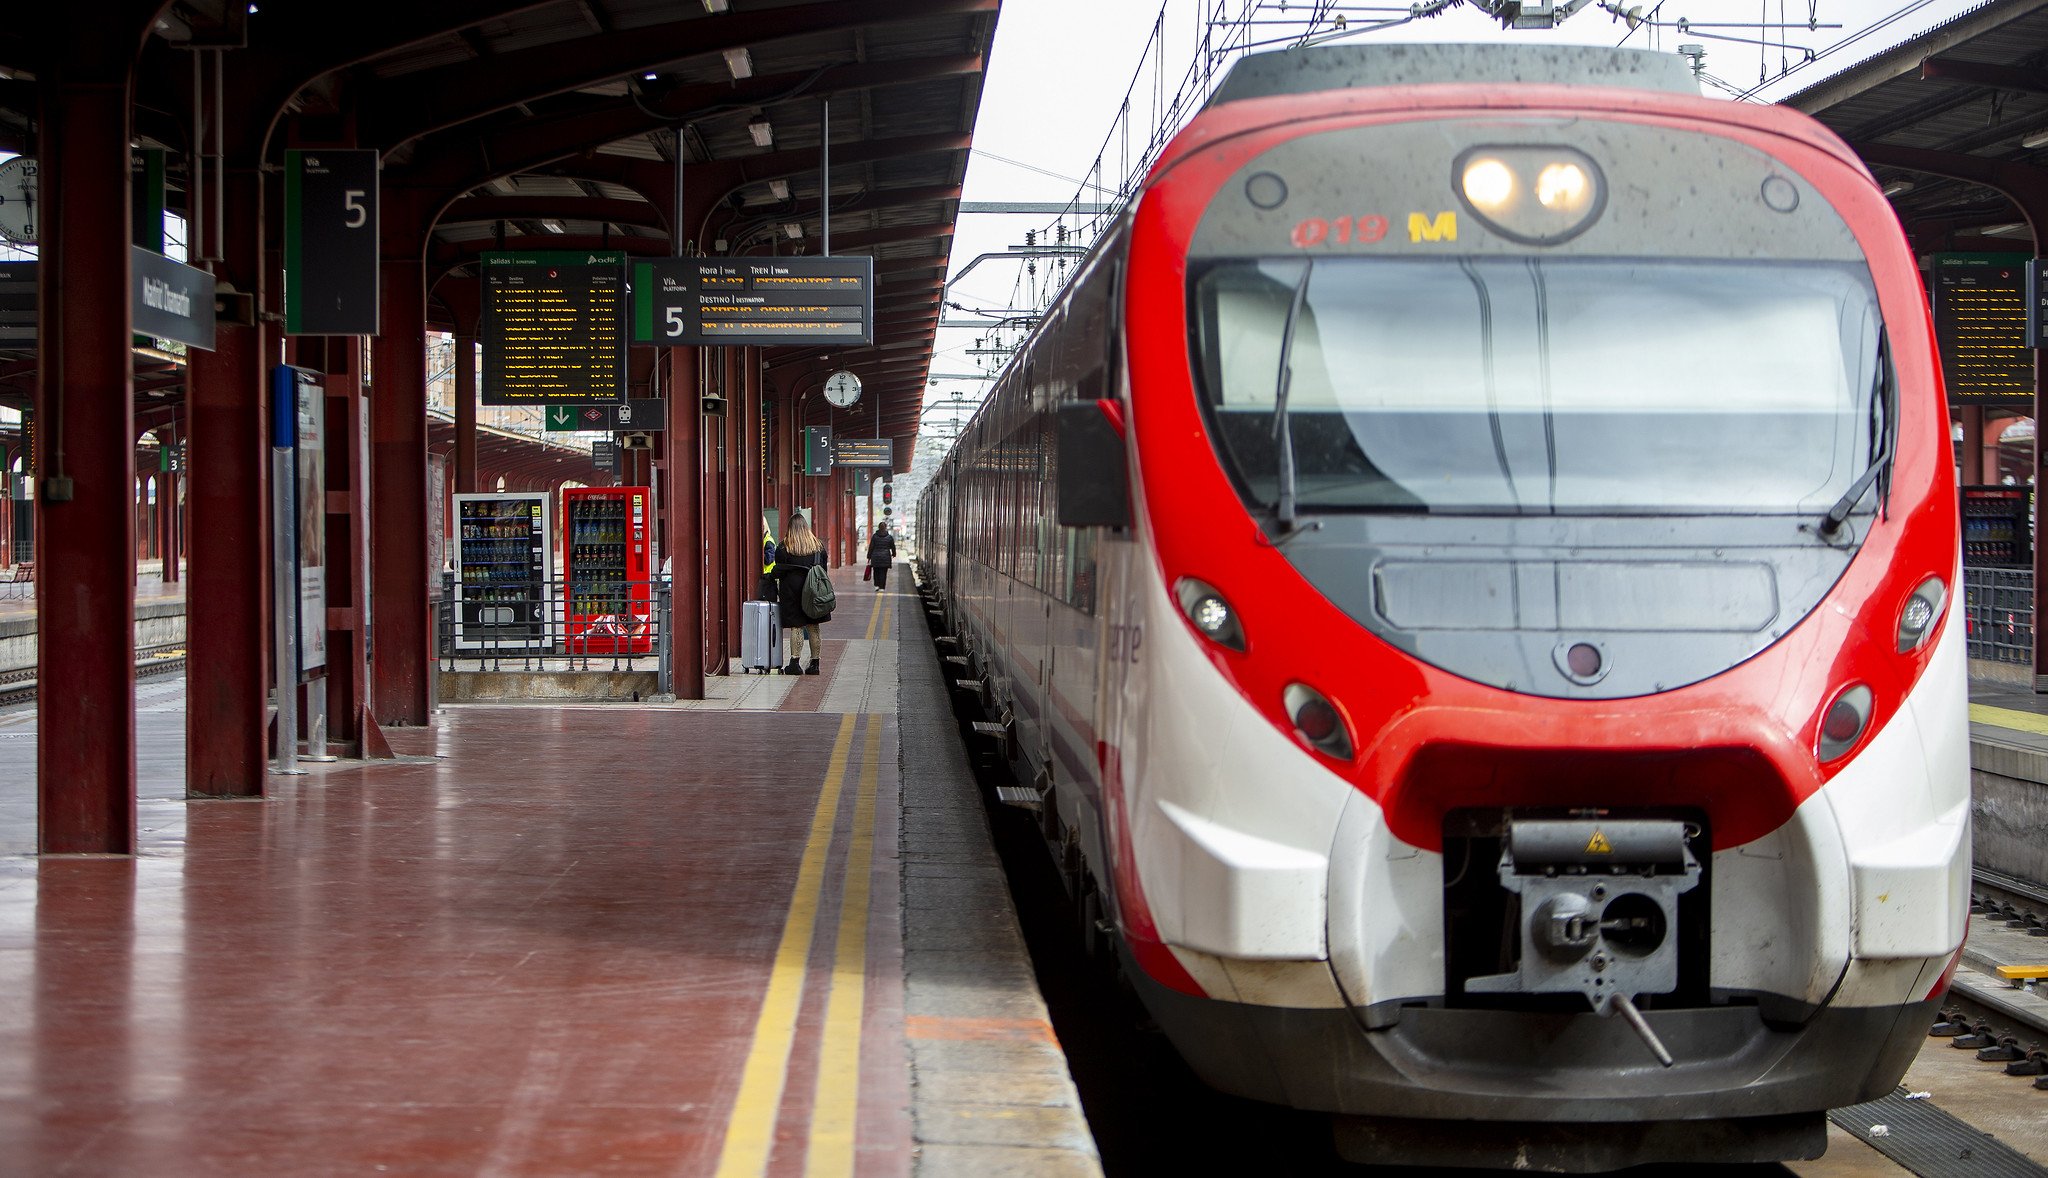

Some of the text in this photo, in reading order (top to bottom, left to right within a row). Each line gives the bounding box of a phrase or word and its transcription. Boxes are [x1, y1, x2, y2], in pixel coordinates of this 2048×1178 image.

[22, 166, 37, 176] 12
[344, 190, 367, 229] 5
[24, 225, 33, 234] 6
[1290, 211, 1458, 249] 019 M
[666, 306, 684, 337] 5
[615, 437, 622, 448] 4
[821, 436, 828, 448] 5
[170, 459, 178, 471] 3
